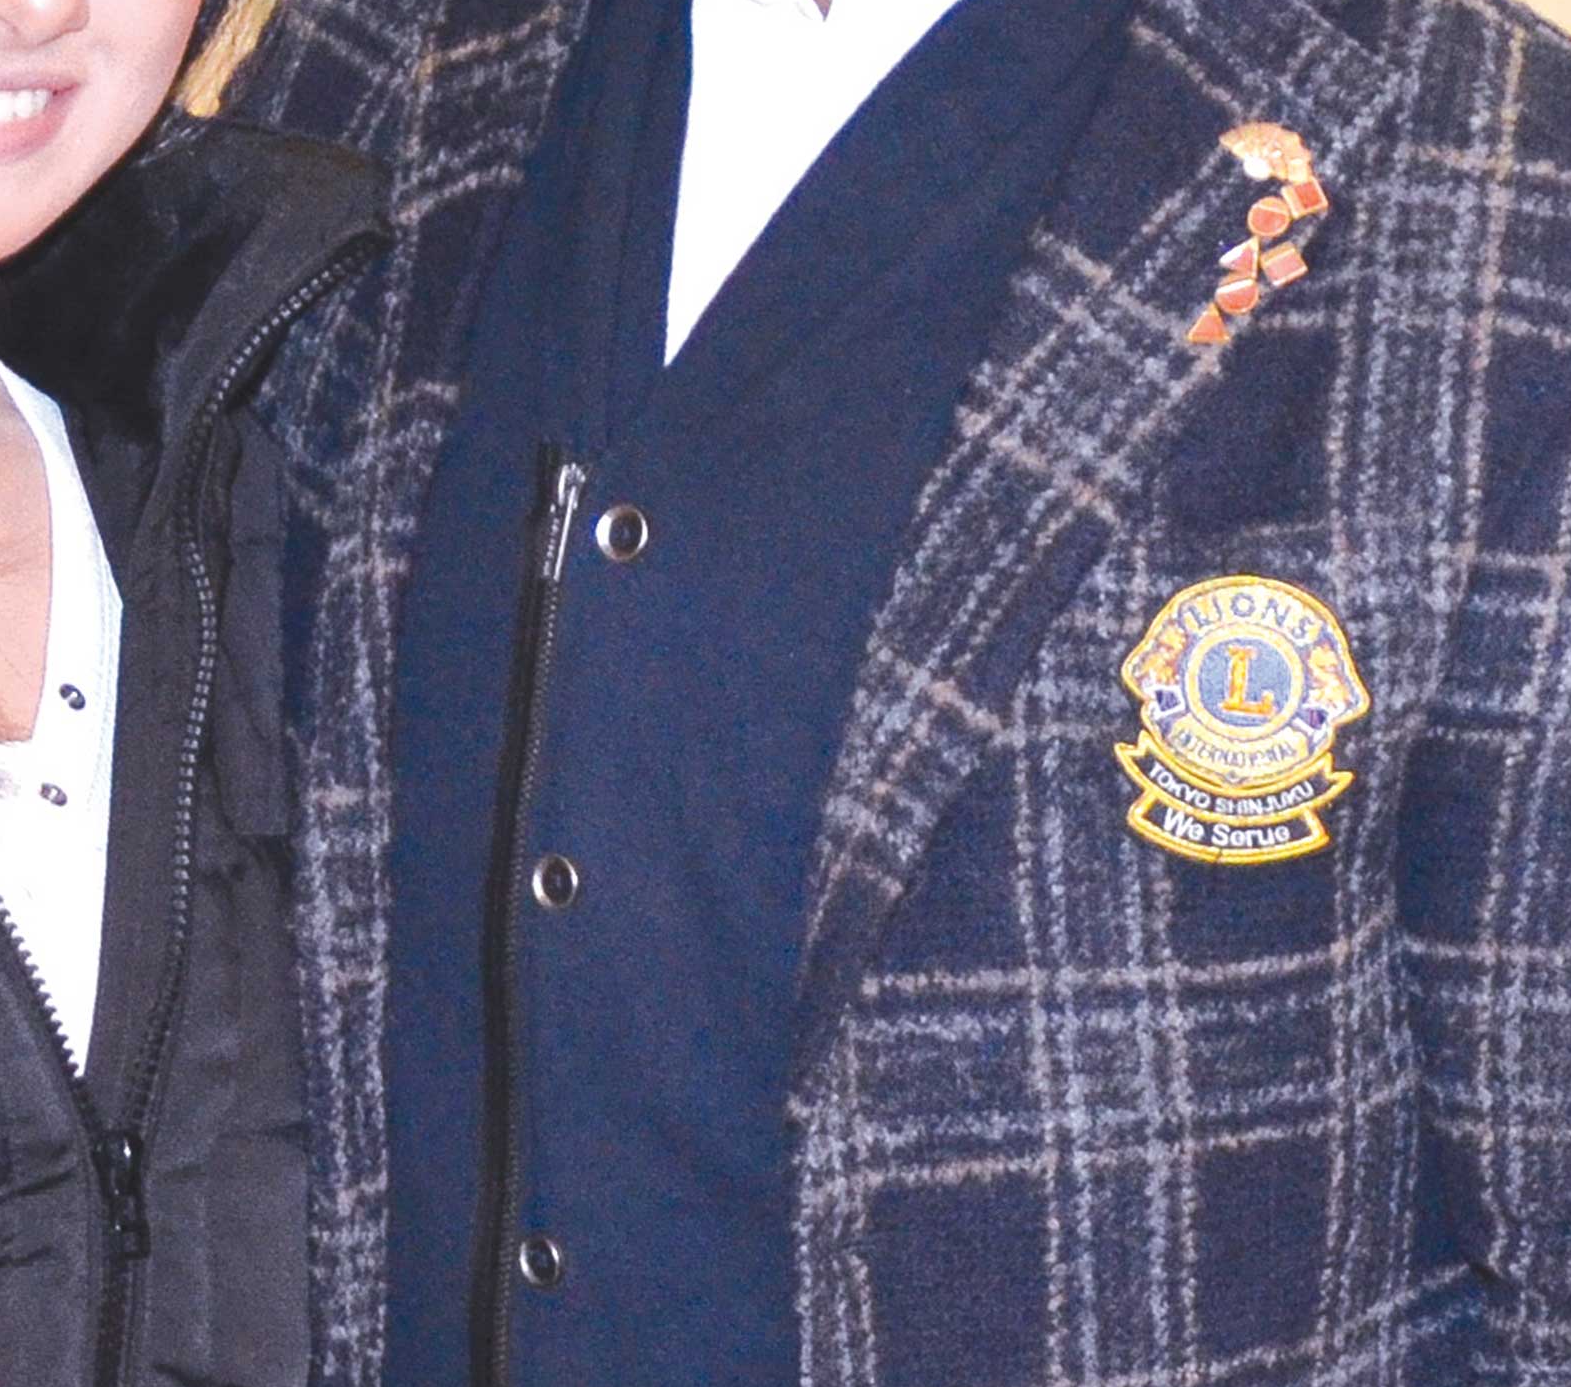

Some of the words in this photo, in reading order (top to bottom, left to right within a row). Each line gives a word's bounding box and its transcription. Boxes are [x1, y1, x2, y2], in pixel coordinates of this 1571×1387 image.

[1188, 592, 1315, 640] LIONS
[1220, 645, 1277, 717] L
[1149, 762, 1211, 809] TOKYO
[1215, 780, 1315, 815] SHINJUKU
[1162, 806, 1206, 841] We
[1211, 823, 1291, 847] Serve
